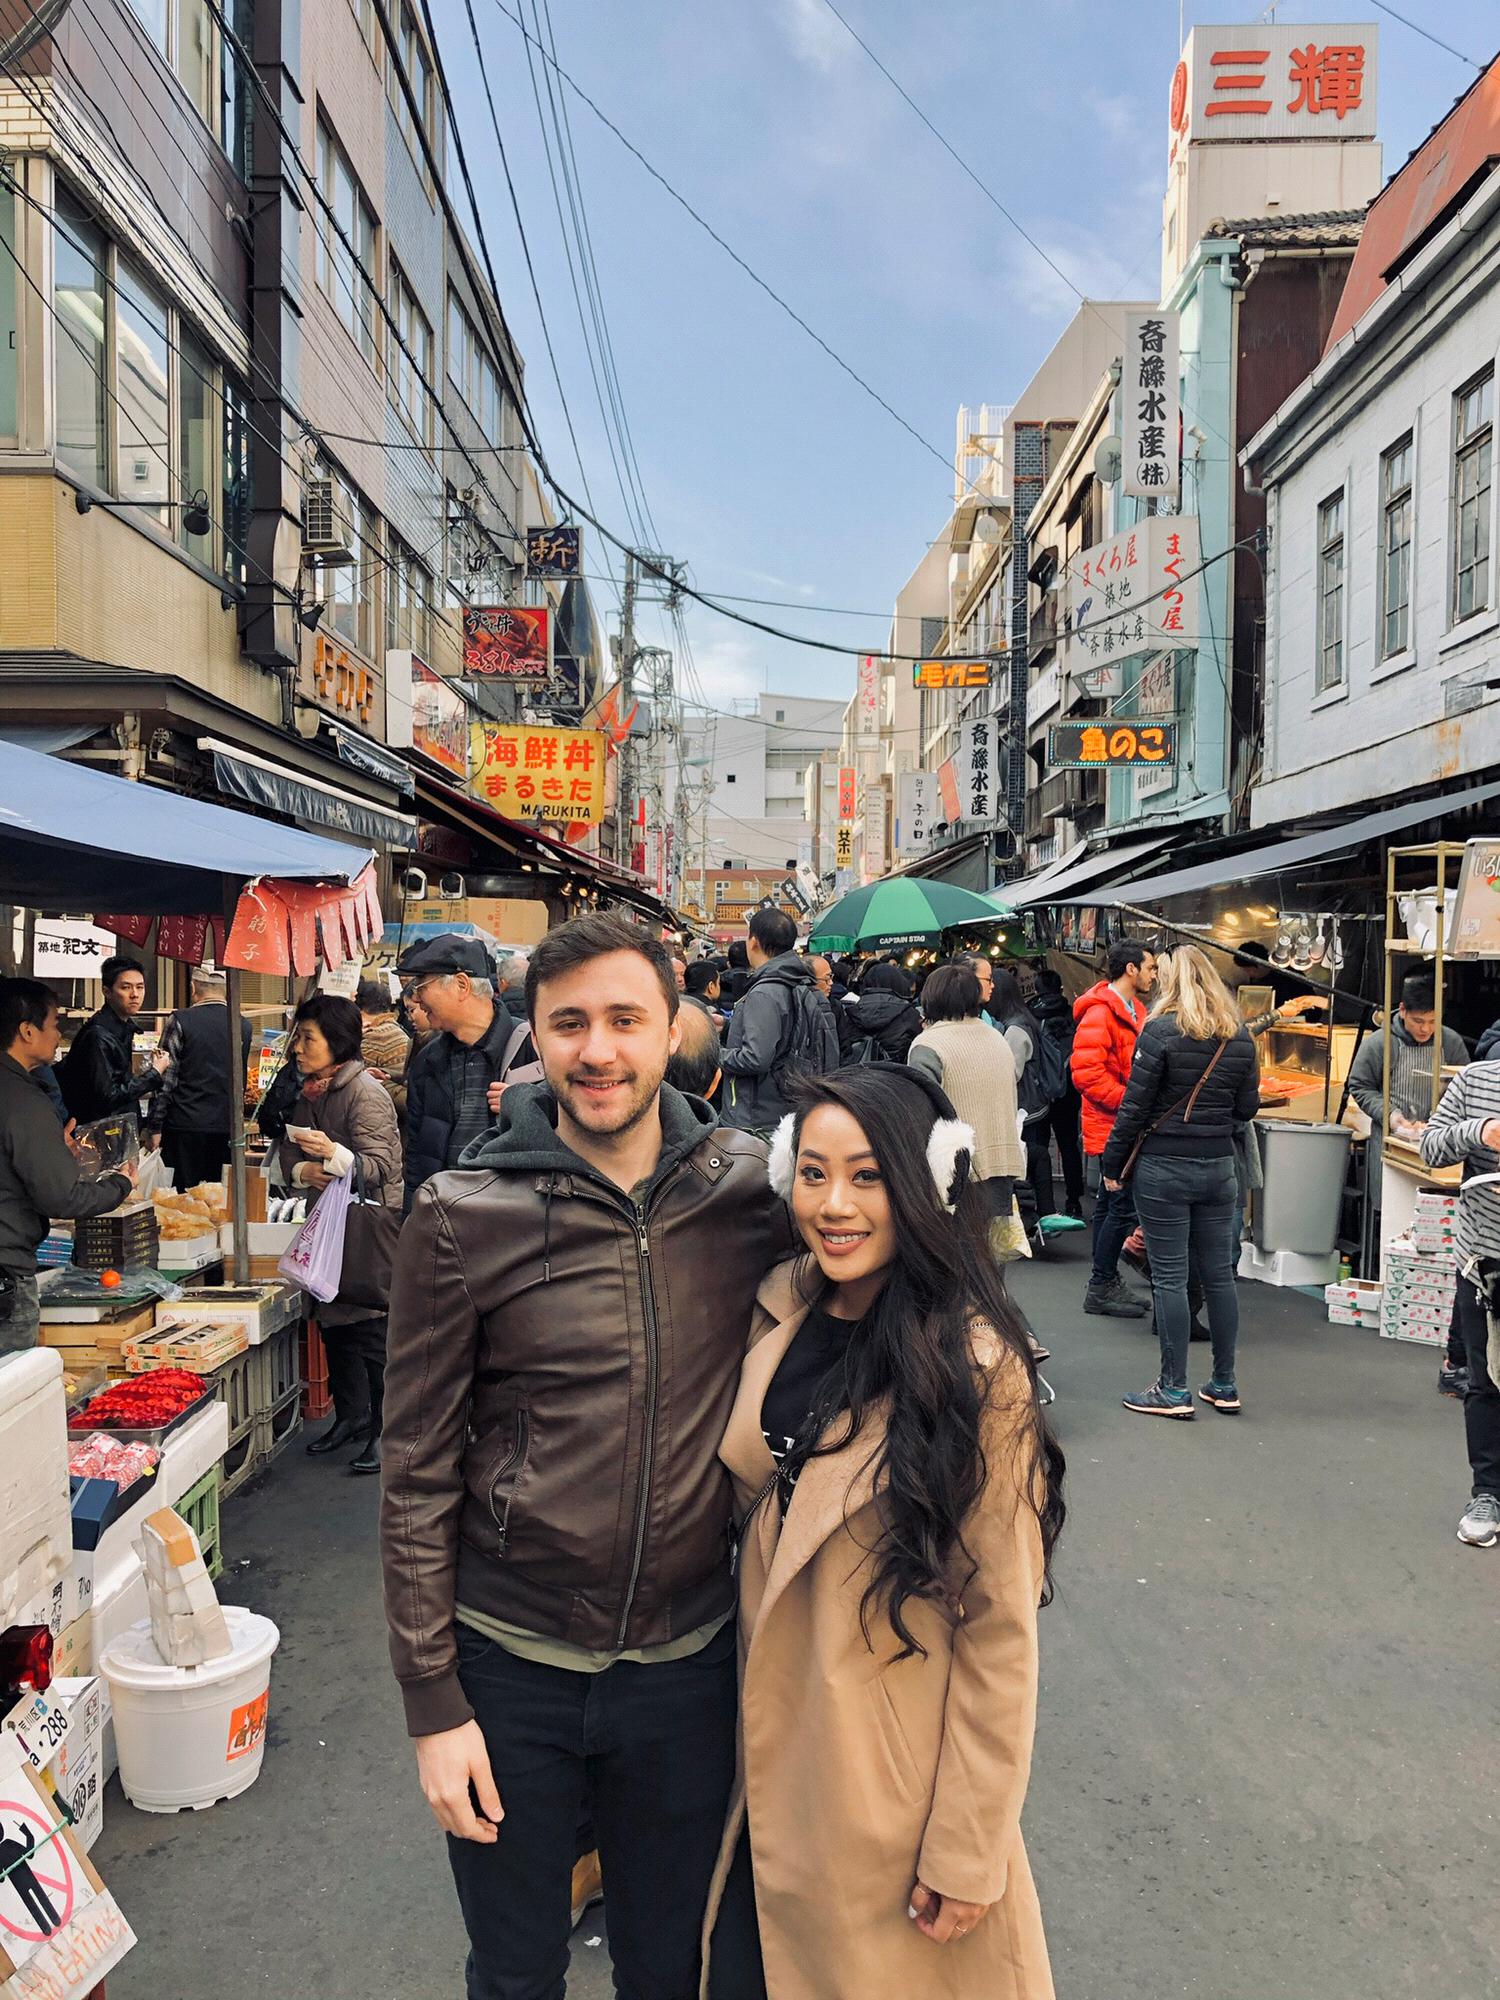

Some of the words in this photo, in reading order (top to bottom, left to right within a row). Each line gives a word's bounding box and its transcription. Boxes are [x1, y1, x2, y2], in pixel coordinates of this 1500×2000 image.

[1204, 43, 1366, 120] 三輝
[1105, 577, 1132, 609] 築地
[1161, 533, 1185, 630] まぐろ屋
[485, 735, 595, 772] 海鮮丼
[484, 773, 592, 802] まるきた
[880, 936, 908, 945] CAPTAIN
